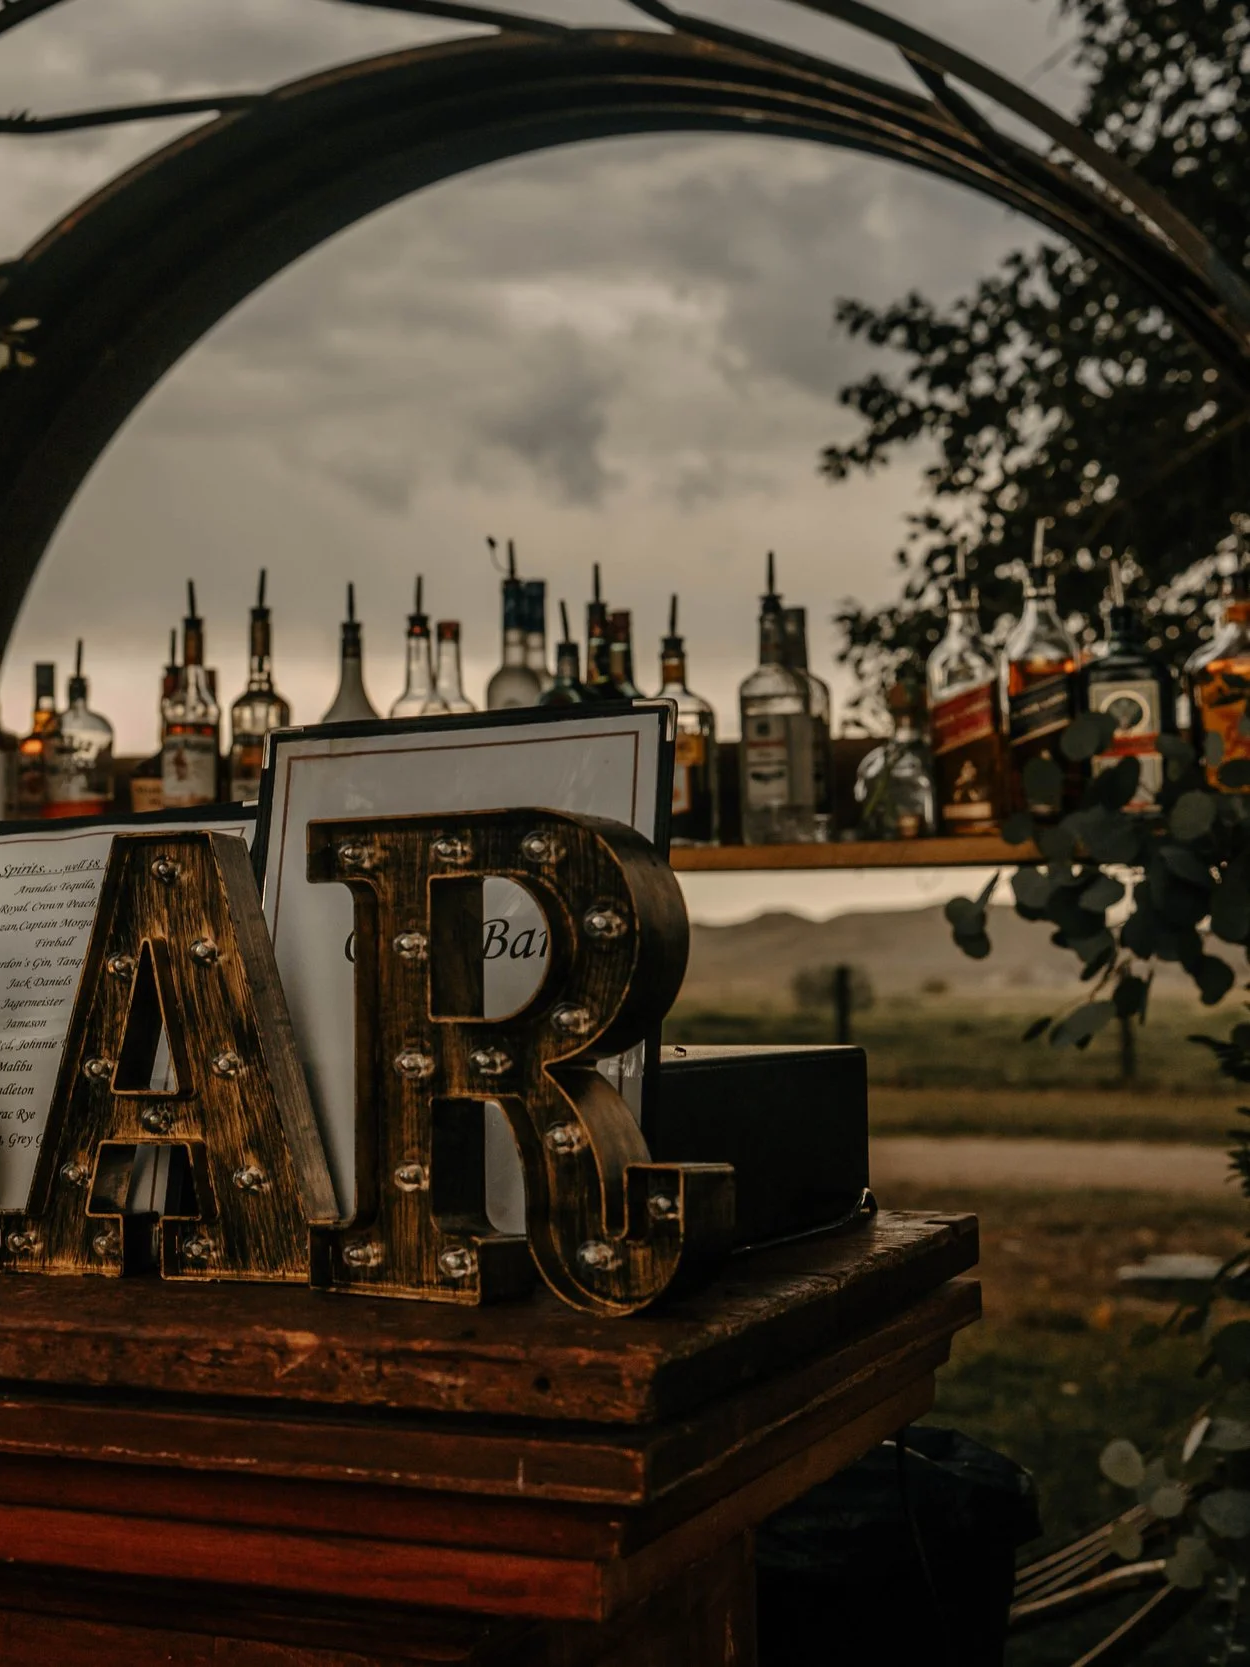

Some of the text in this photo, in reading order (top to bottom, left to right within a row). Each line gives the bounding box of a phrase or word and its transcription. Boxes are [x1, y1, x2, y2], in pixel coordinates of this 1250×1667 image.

[14, 879, 96, 896] Arandas Tequila,
[0, 901, 30, 916] Royal,
[31, 901, 65, 912] Crown
[59, 918, 93, 930] Morga
[34, 936, 77, 948] Fireball
[31, 957, 52, 971] Gin,
[56, 956, 84, 968] Tanq
[6, 975, 73, 989] Jack Daniels
[3, 1018, 47, 1031] Jameson
[16, 1038, 58, 1051] Johnnie
[16, 1108, 37, 1124] Rye
[8, 1132, 34, 1148] Grey
